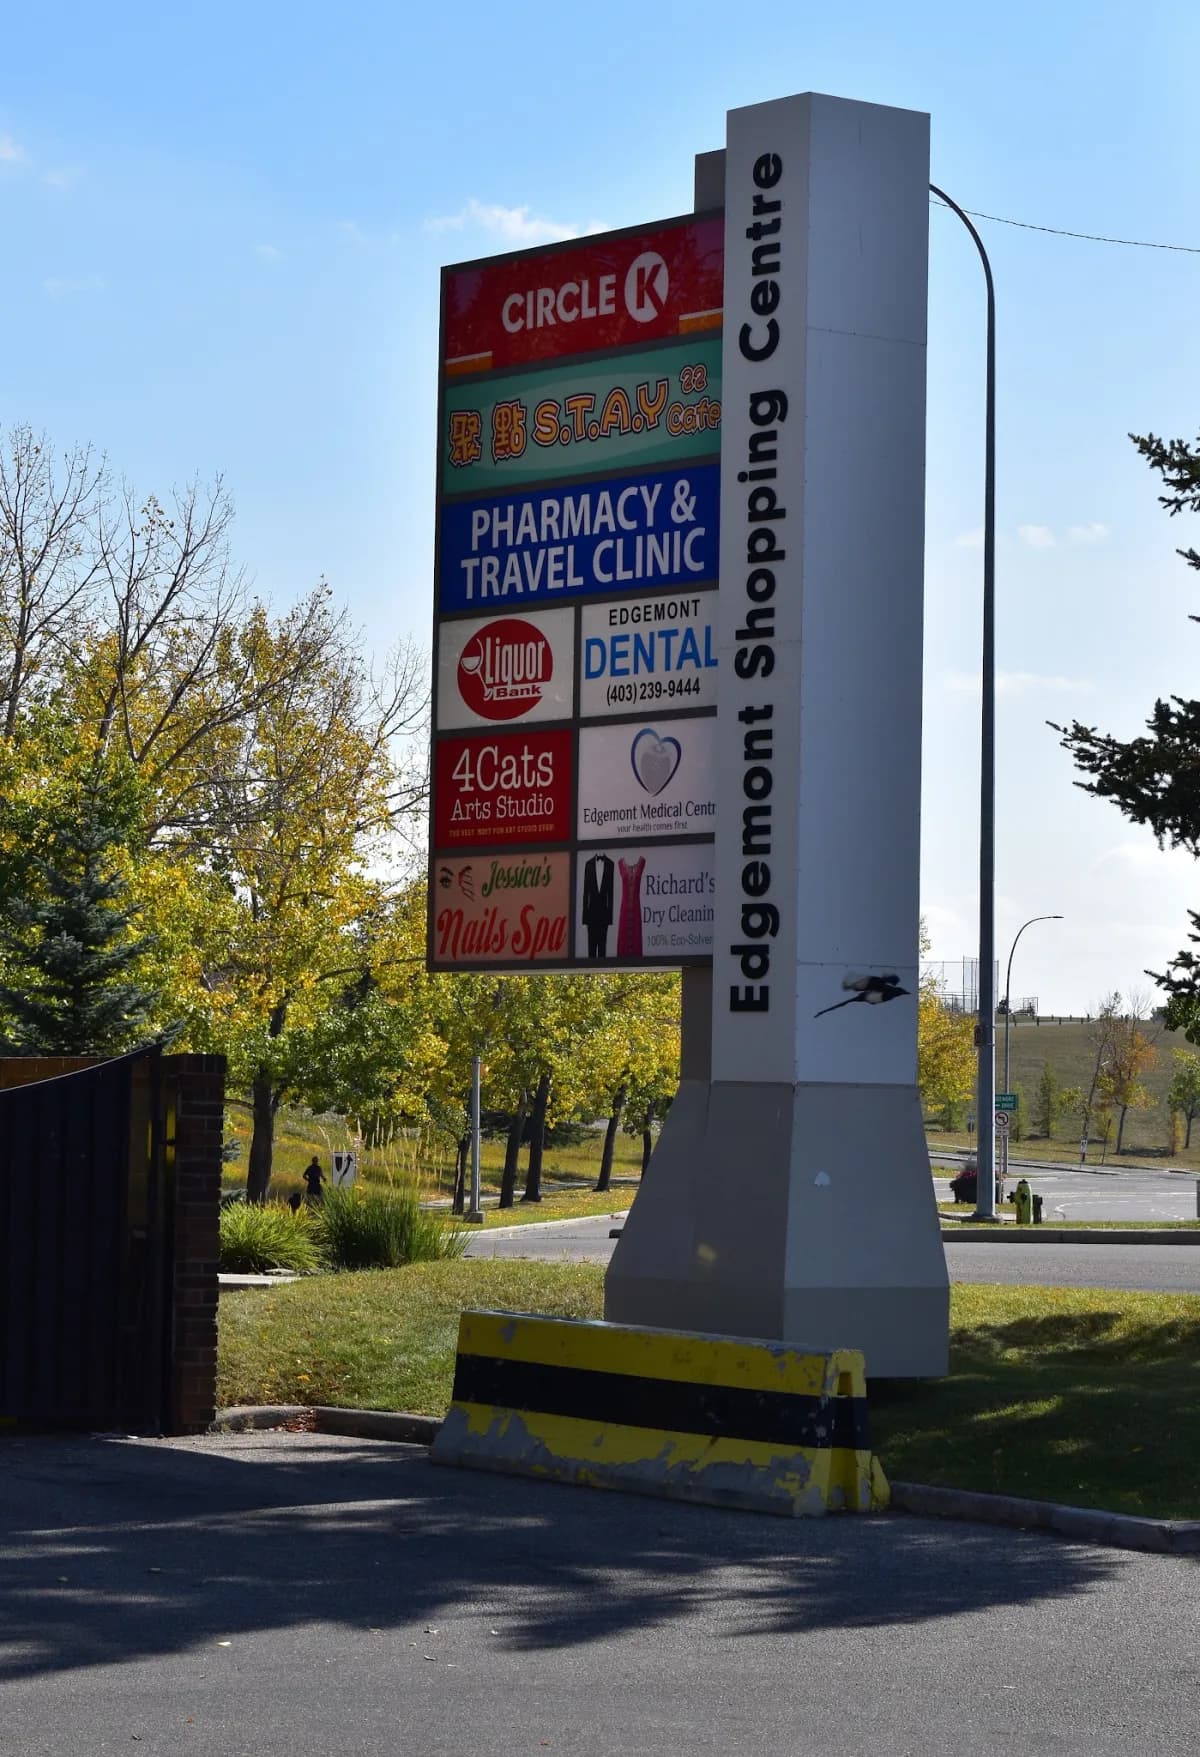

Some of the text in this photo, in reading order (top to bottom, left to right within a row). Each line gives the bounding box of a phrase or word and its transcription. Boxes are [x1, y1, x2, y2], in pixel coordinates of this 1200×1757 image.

[502, 261, 668, 333] CIRCLE K
[471, 479, 697, 551] PHARMACY &
[461, 527, 705, 600] TRAVEL CLINIC
[729, 152, 788, 1013] Edgemont Shopping Centre
[609, 599, 700, 626] EDGEMONT
[484, 637, 545, 689] Liquor
[585, 625, 718, 680] DENTAL
[495, 685, 542, 698] Bank
[452, 745, 554, 792] 4Cats
[450, 793, 555, 822] Arts Studio
[584, 804, 637, 826] Edgemont
[640, 802, 683, 819] Medical
[617, 820, 688, 834] your health comes first
[482, 856, 552, 897] Jessica's
[646, 872, 715, 896] Richard's
[437, 904, 567, 961] Nails Spa
[643, 907, 665, 928] Dry
